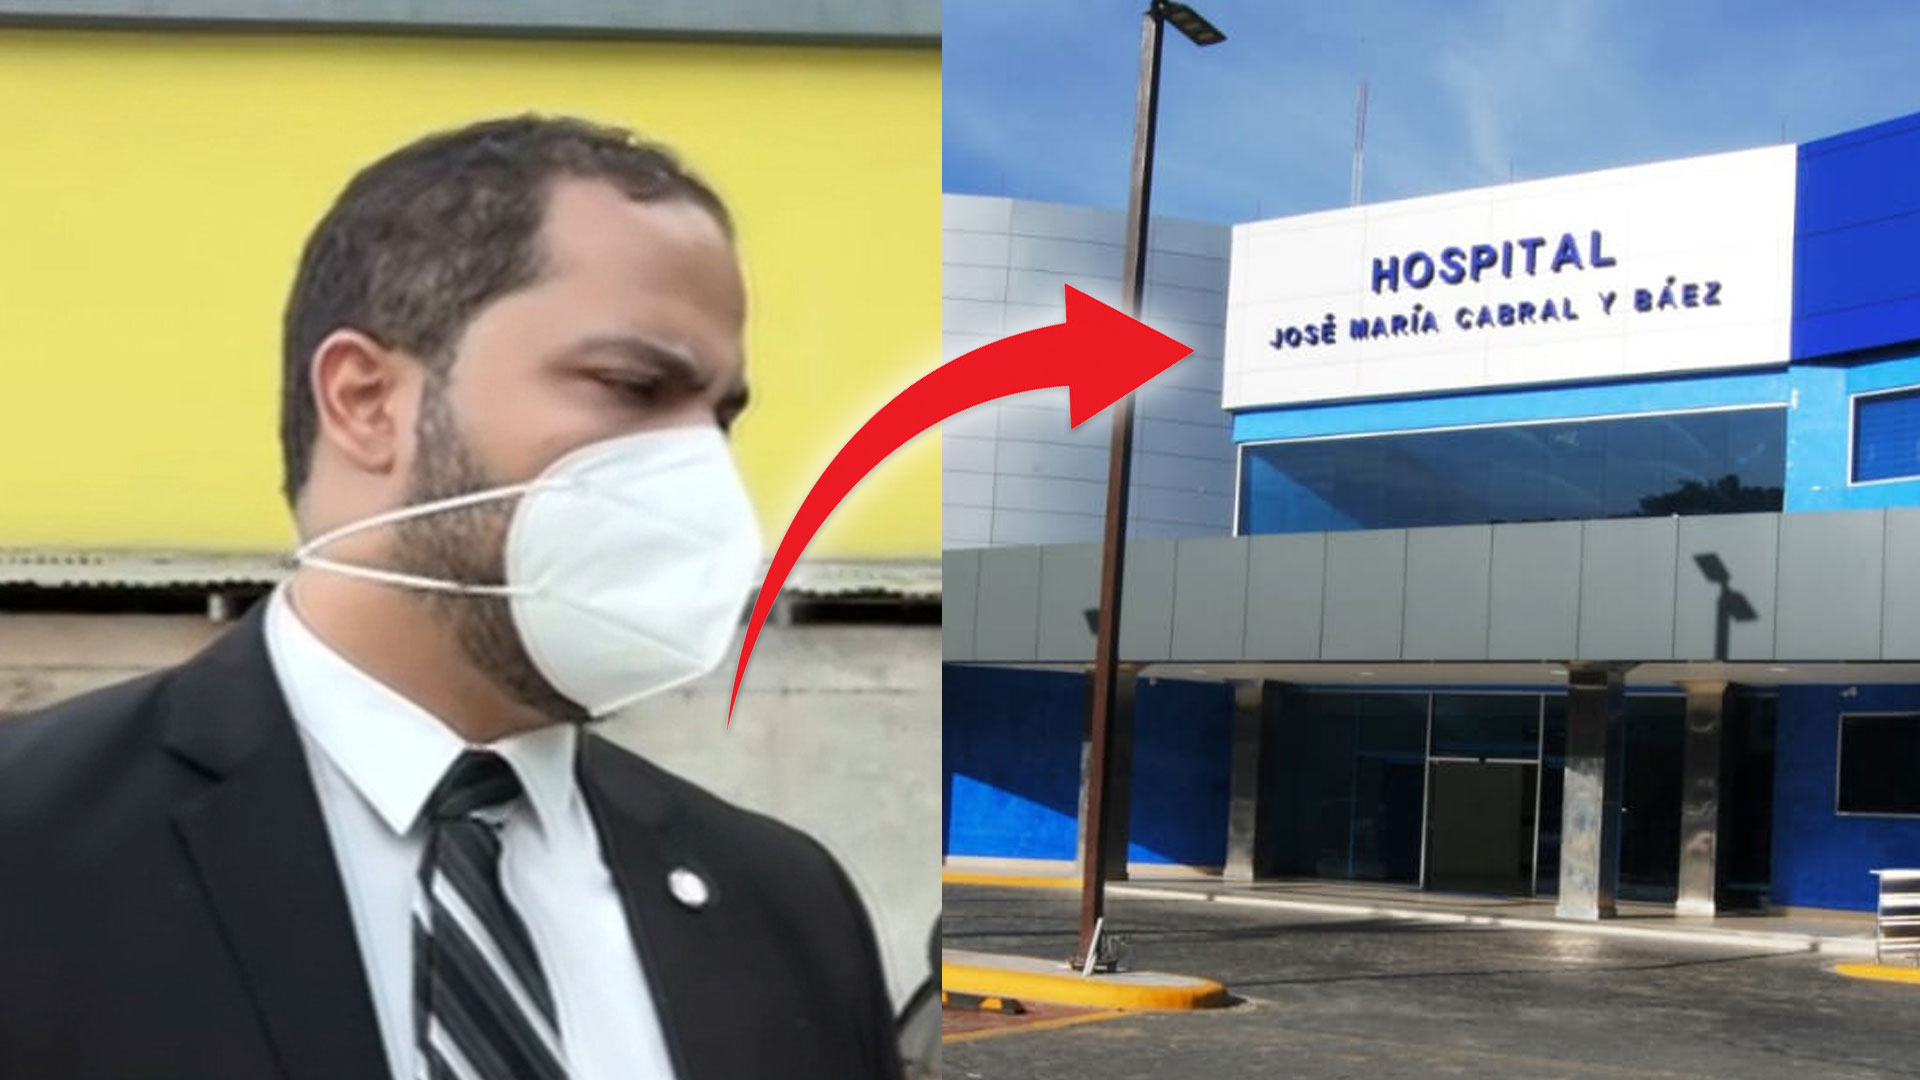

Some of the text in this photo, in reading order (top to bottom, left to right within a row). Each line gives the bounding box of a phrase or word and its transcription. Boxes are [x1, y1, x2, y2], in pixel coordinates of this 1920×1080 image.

[1371, 230, 1617, 295] HOSPITAL
[1269, 276, 1722, 350] JOSÉ MARÍA CABRAL Y BÁEZ
